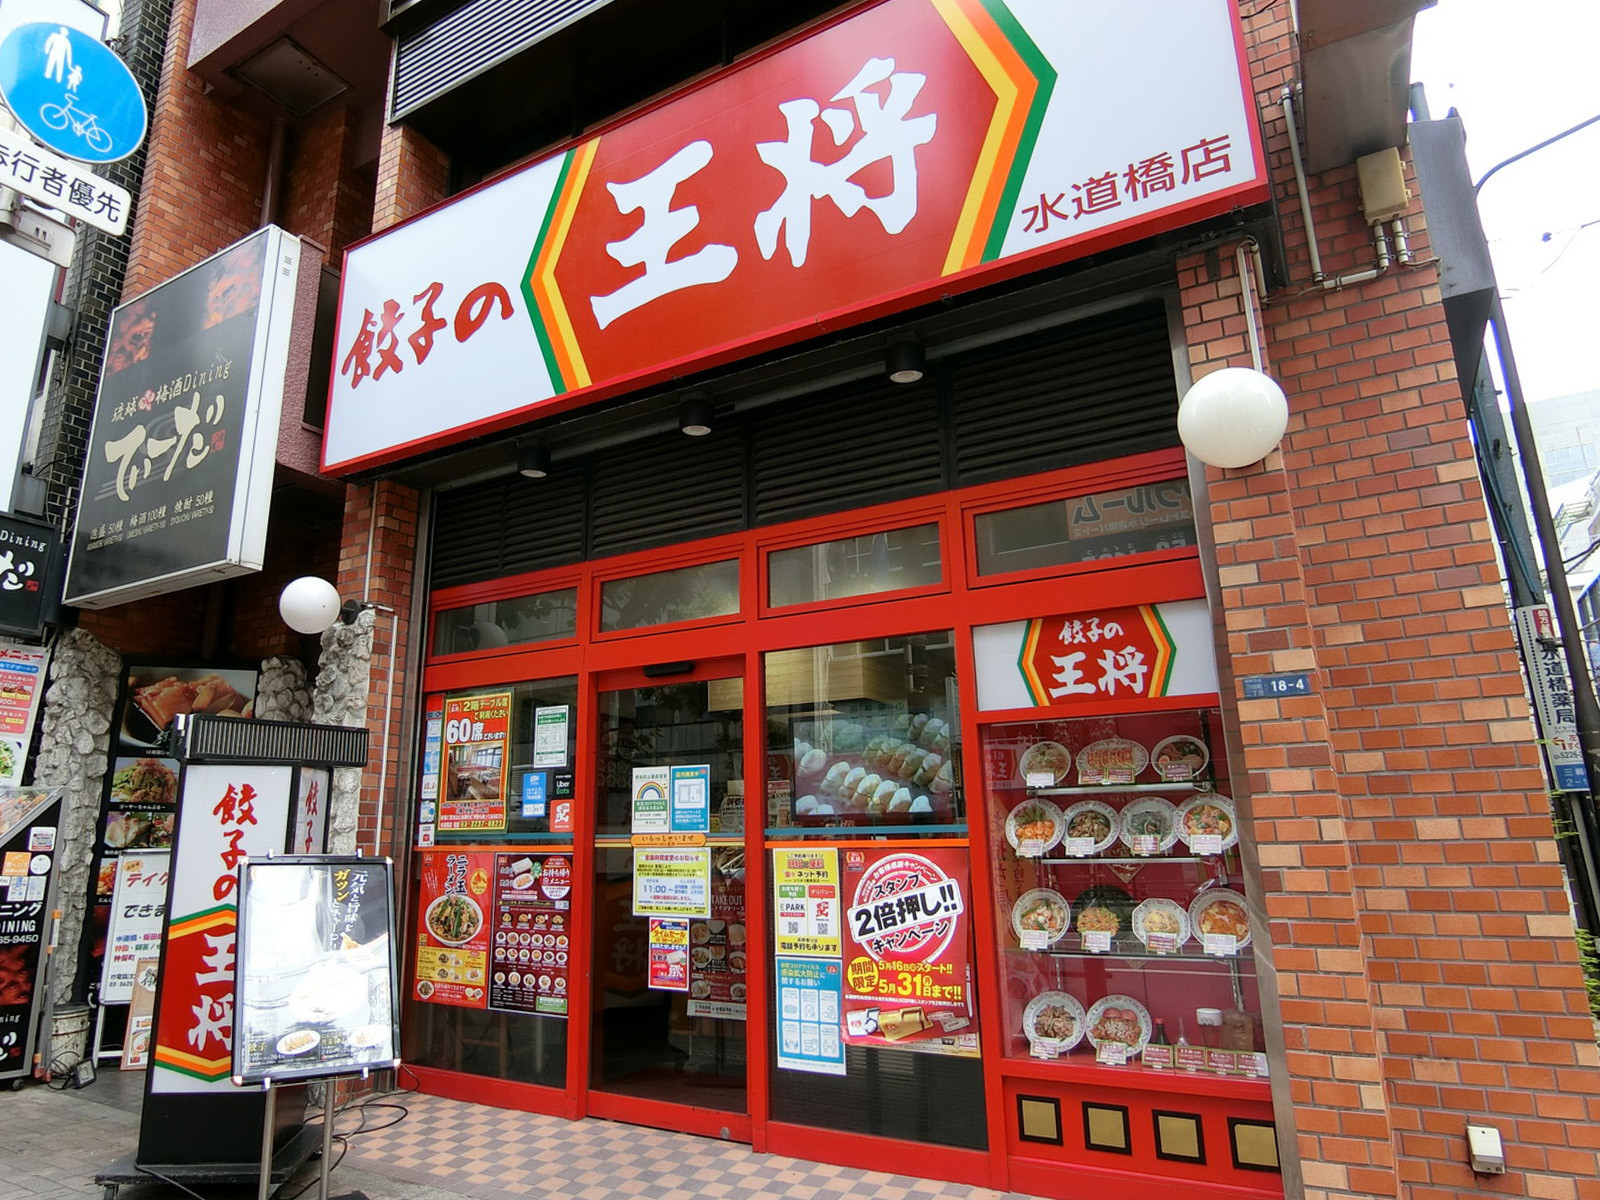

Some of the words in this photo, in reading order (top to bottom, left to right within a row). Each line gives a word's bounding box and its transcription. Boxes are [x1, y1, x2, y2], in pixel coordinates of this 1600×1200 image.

[590, 56, 937, 331] 王将
[1021, 134, 1232, 234] 水道橋店
[341, 281, 515, 389] 餃子の
[0, 529, 47, 552] Dining
[1058, 617, 1124, 645] 餃子の
[1048, 645, 1148, 699] 王将
[1271, 678, 1305, 692] 18-4
[874, 871, 921, 898] スタンプ
[855, 884, 958, 937] 2倍押し!!
[0, 920, 36, 933] INING
[873, 921, 949, 953] キャンペーン
[851, 960, 874, 975] 期間
[853, 975, 875, 989] 限定
